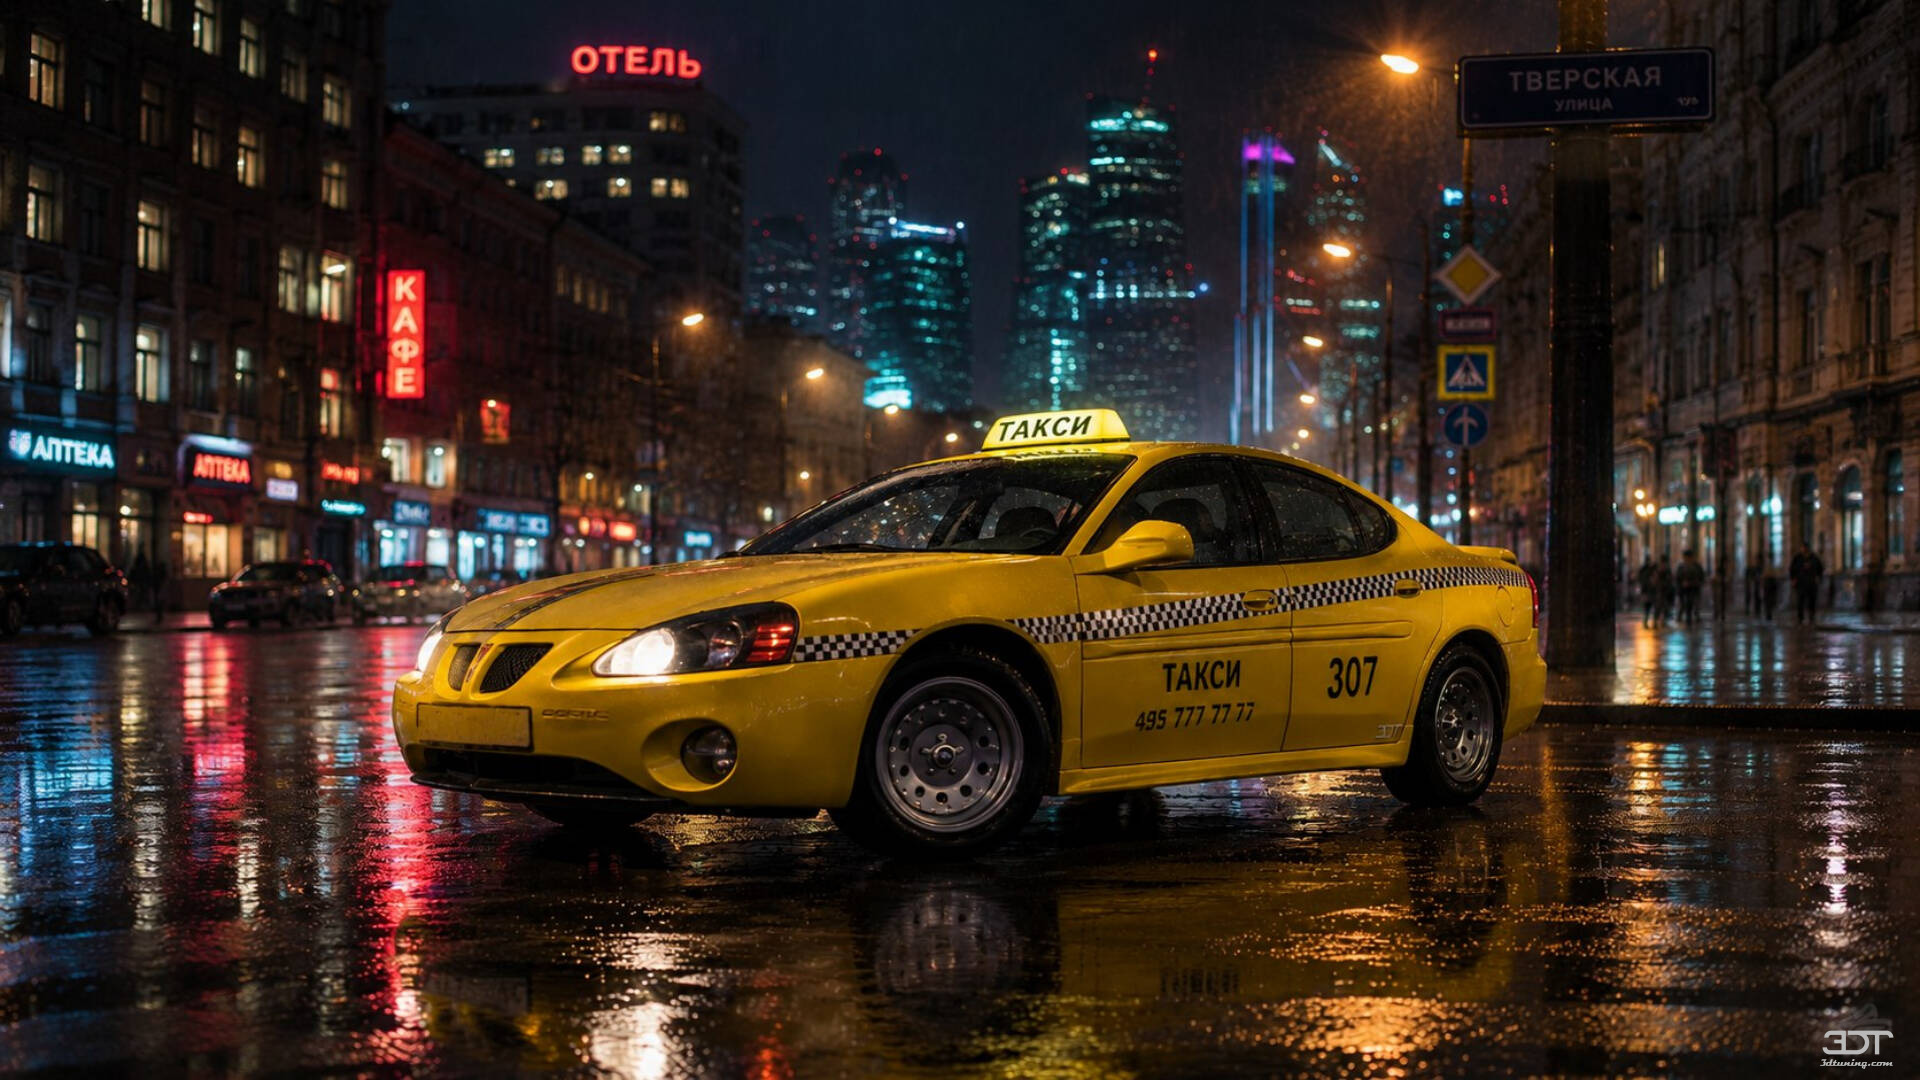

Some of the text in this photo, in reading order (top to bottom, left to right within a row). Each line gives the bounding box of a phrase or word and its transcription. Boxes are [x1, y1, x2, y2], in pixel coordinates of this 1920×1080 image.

[571, 45, 702, 79] ОТЕЛЬ
[1508, 66, 1661, 92] ТВЕРСКАЯ
[1554, 98, 1614, 112] УЛИЦА
[391, 276, 419, 393] КАФЕ
[999, 415, 1092, 442] ТАКСИ
[32, 435, 114, 469] АПТЕКА
[193, 453, 251, 484] АПТЕКА
[1162, 660, 1241, 692] ТАКСИ
[1327, 655, 1378, 699] 307
[1135, 702, 1255, 731] 495 777 77 77
